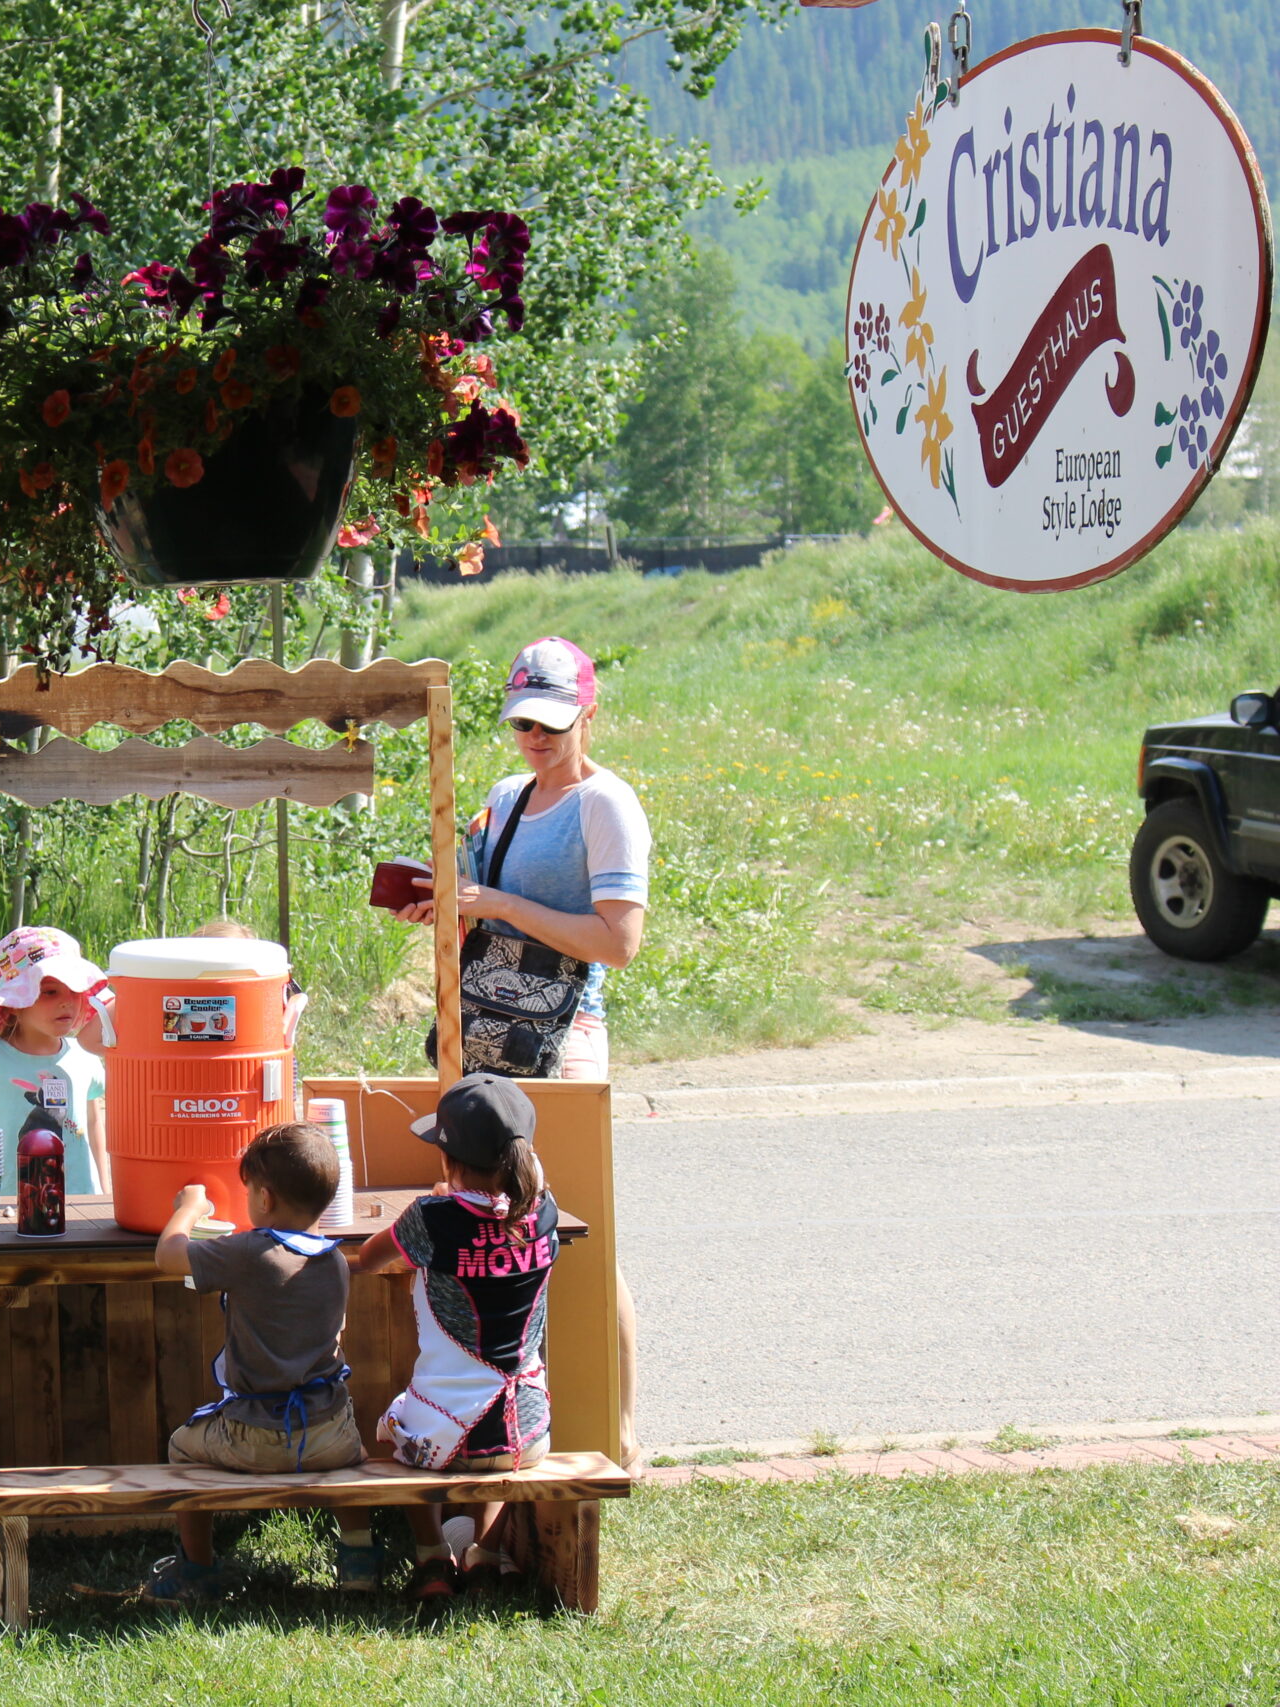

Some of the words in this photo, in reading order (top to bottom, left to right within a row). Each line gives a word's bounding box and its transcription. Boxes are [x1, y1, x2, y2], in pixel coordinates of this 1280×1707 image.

[947, 82, 1173, 304] Cristiana
[992, 278, 1104, 459] GUESTHAUS
[1055, 447, 1122, 492] European
[1042, 491, 1077, 541] Style
[1080, 487, 1122, 539] Lodge
[173, 1098, 239, 1113] IGLOO
[457, 1235, 552, 1277] MOVE
